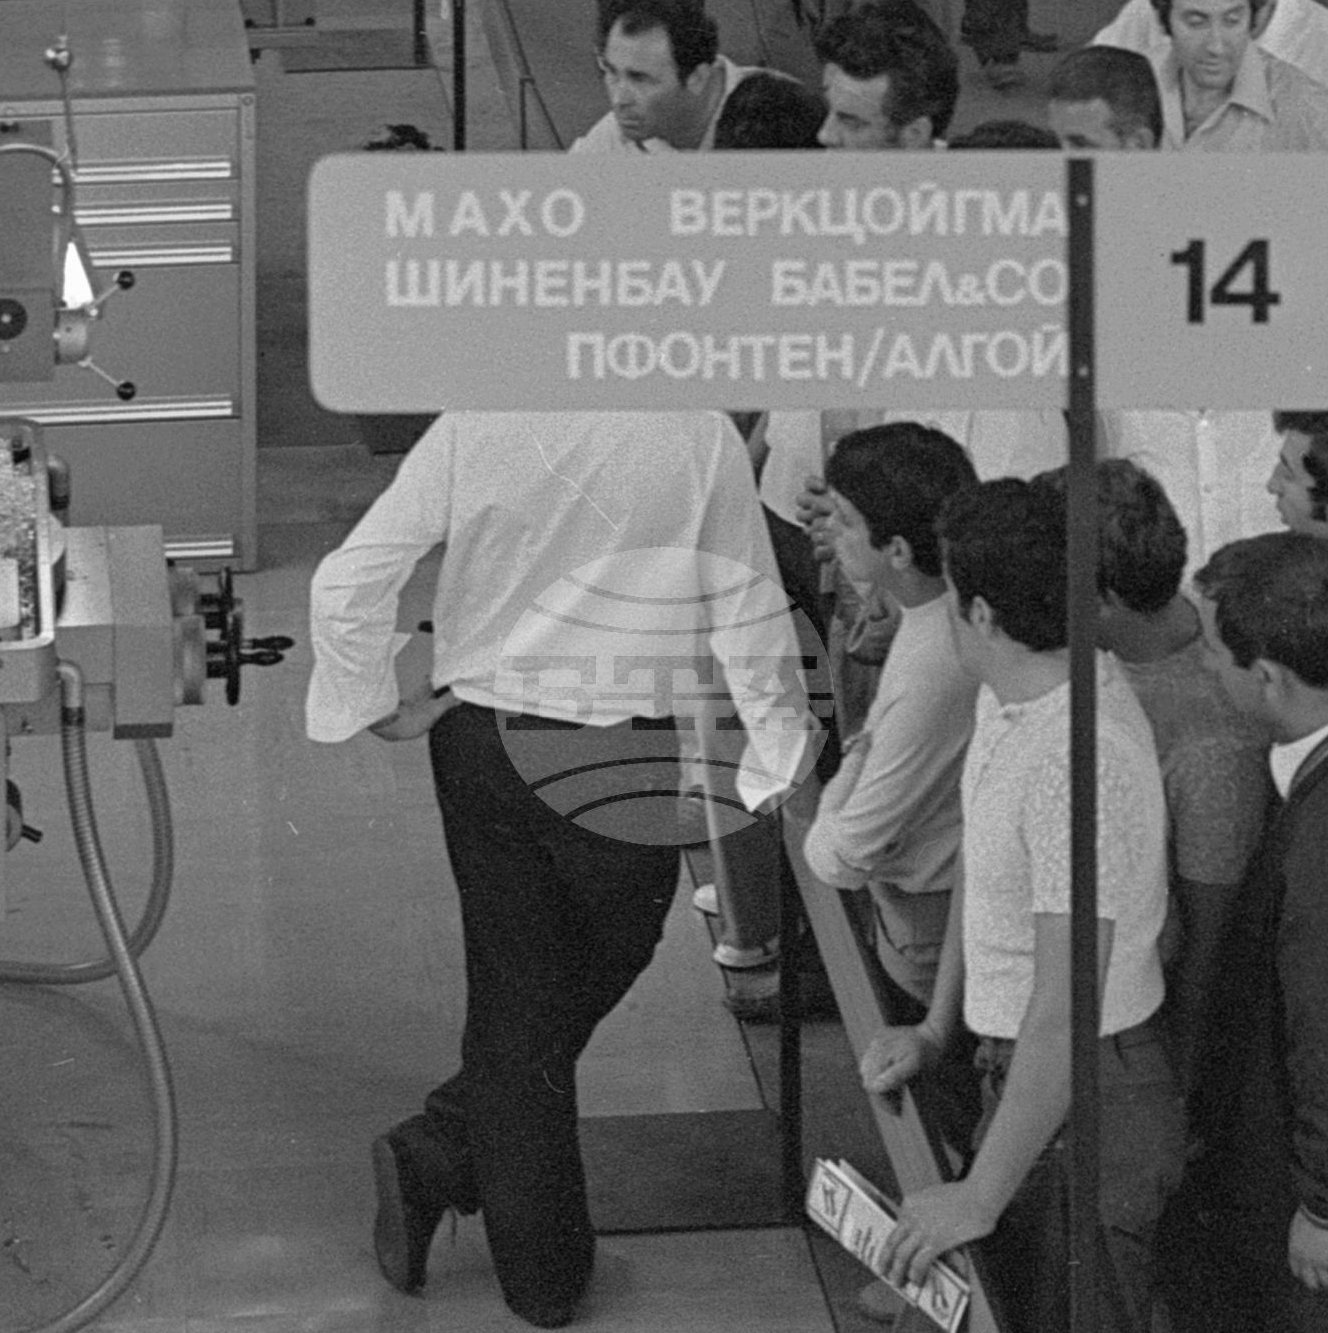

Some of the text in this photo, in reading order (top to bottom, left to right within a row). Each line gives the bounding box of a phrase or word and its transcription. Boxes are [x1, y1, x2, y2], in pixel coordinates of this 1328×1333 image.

[385, 182, 1068, 245] МАХО ВЕРКЦОЙГМА
[385, 259, 726, 307] ШИНЕНБАУ
[1170, 238, 1282, 325] 14
[567, 326, 1069, 387] ПФОНТЕН/АЛГОЙ
